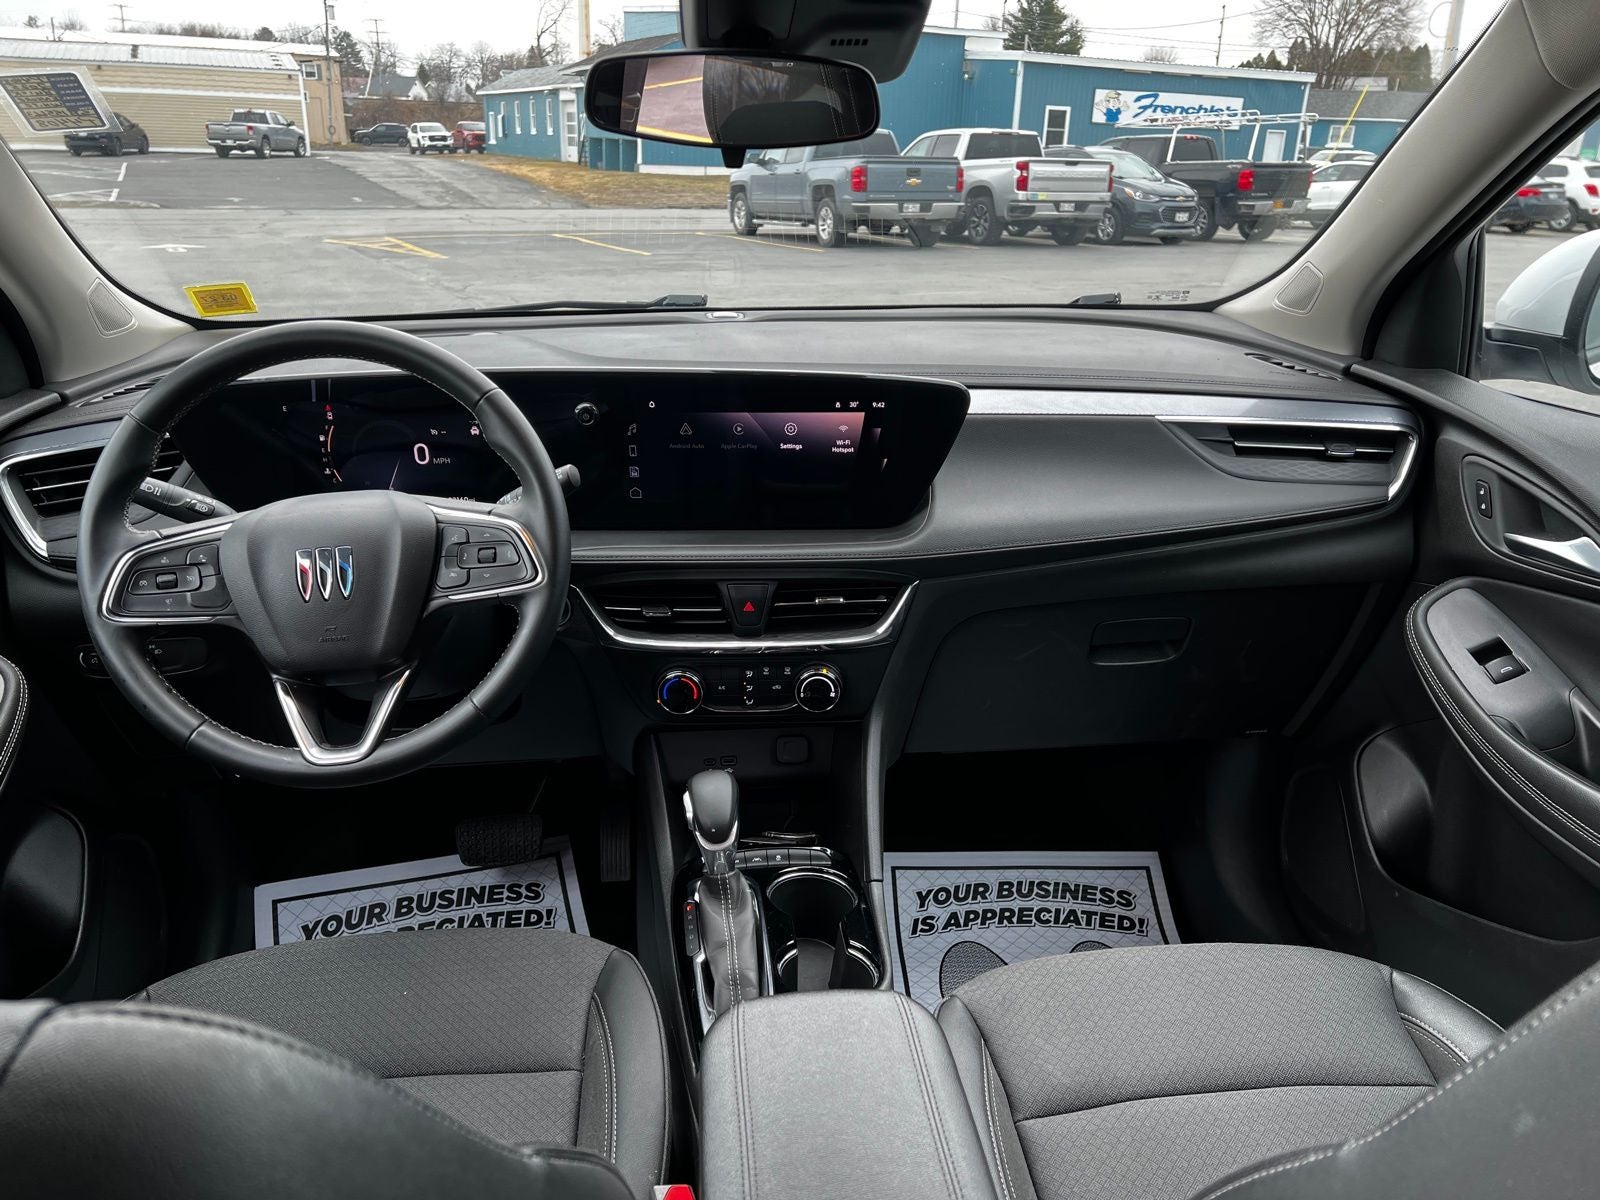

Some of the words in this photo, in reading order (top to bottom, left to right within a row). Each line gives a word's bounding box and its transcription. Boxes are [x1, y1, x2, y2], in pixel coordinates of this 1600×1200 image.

[1133, 93, 1239, 118] Frenchie's
[413, 443, 430, 465] 0
[432, 457, 451, 465] MPH
[300, 902, 390, 940] YOUR
[393, 882, 546, 921] BUSINESS
[915, 882, 992, 912] YOUR
[995, 879, 1138, 910] BUSINESS
[909, 914, 939, 937] IS
[940, 906, 1149, 937] APPRECIATED!
